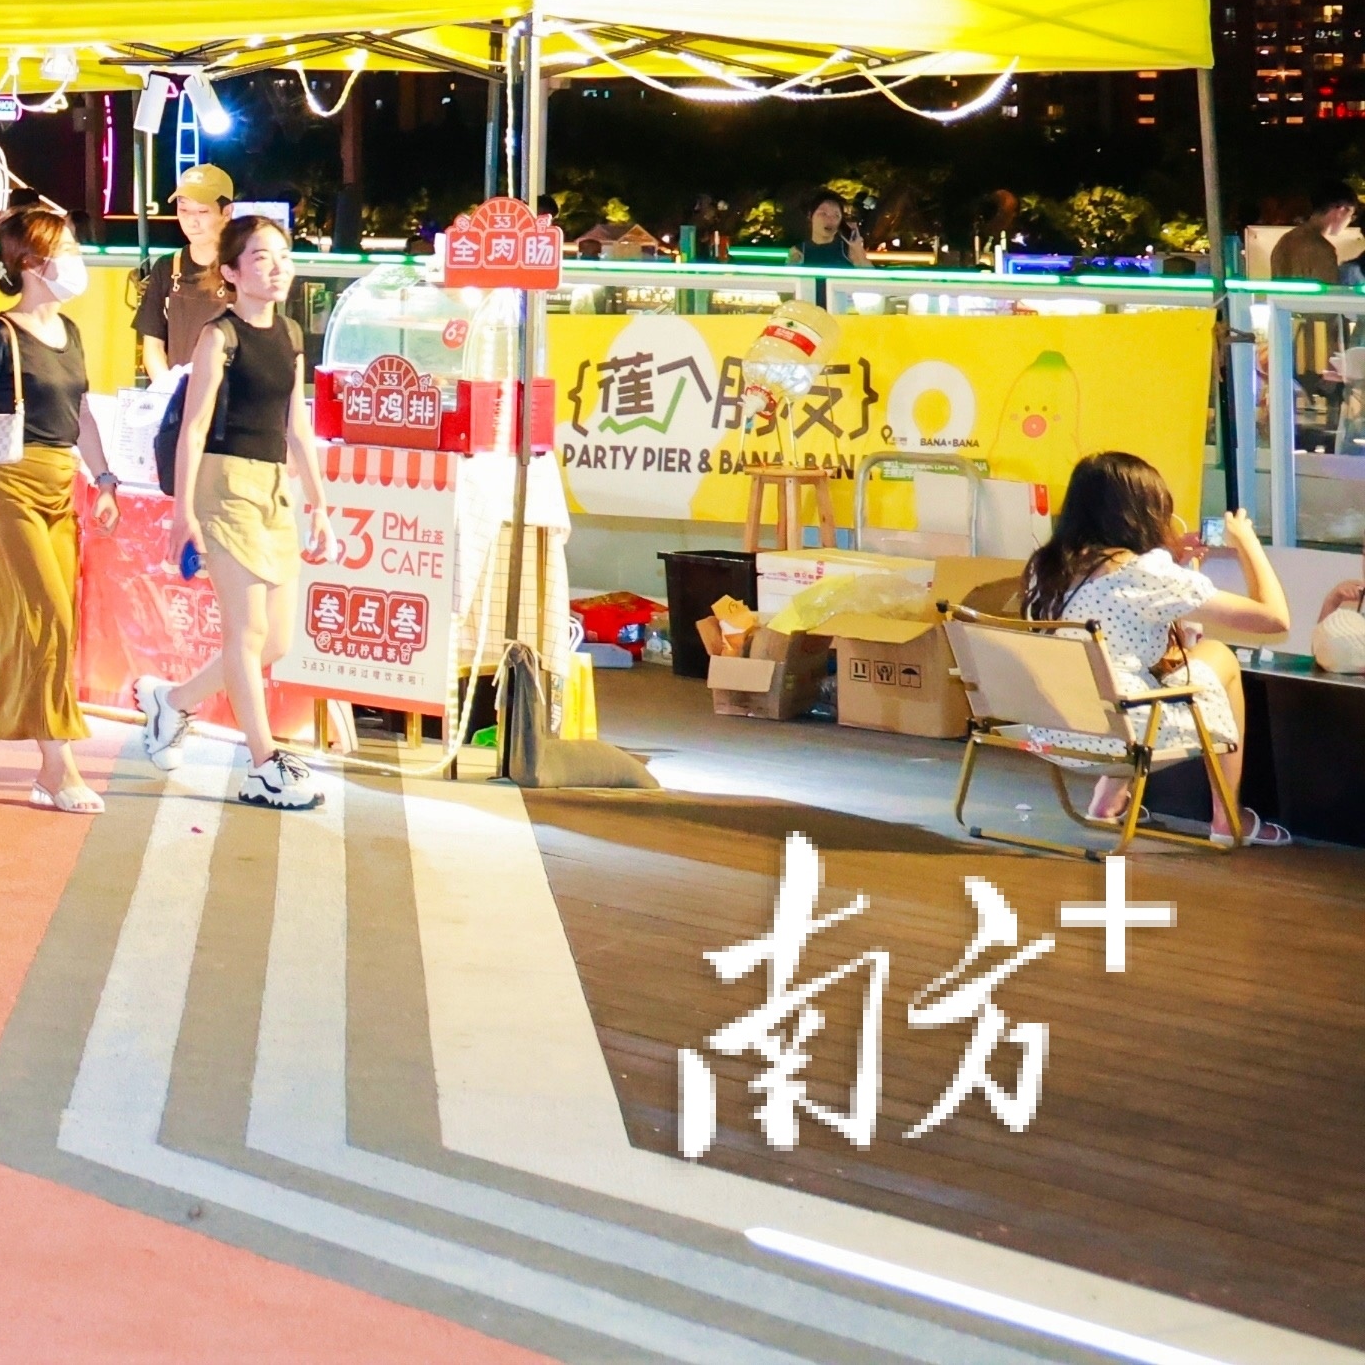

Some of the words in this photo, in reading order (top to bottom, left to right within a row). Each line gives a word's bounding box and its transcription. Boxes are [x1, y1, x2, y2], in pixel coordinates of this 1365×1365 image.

[451, 235, 554, 265] 全肉肠
[347, 390, 435, 425] 炸鸡排
[563, 443, 638, 469] PARTY
[644, 447, 692, 473] PIER
[697, 448, 713, 473] &
[382, 511, 418, 542] PM
[380, 547, 444, 579] CAFE
[333, 640, 397, 660] 手打柠檬茶
